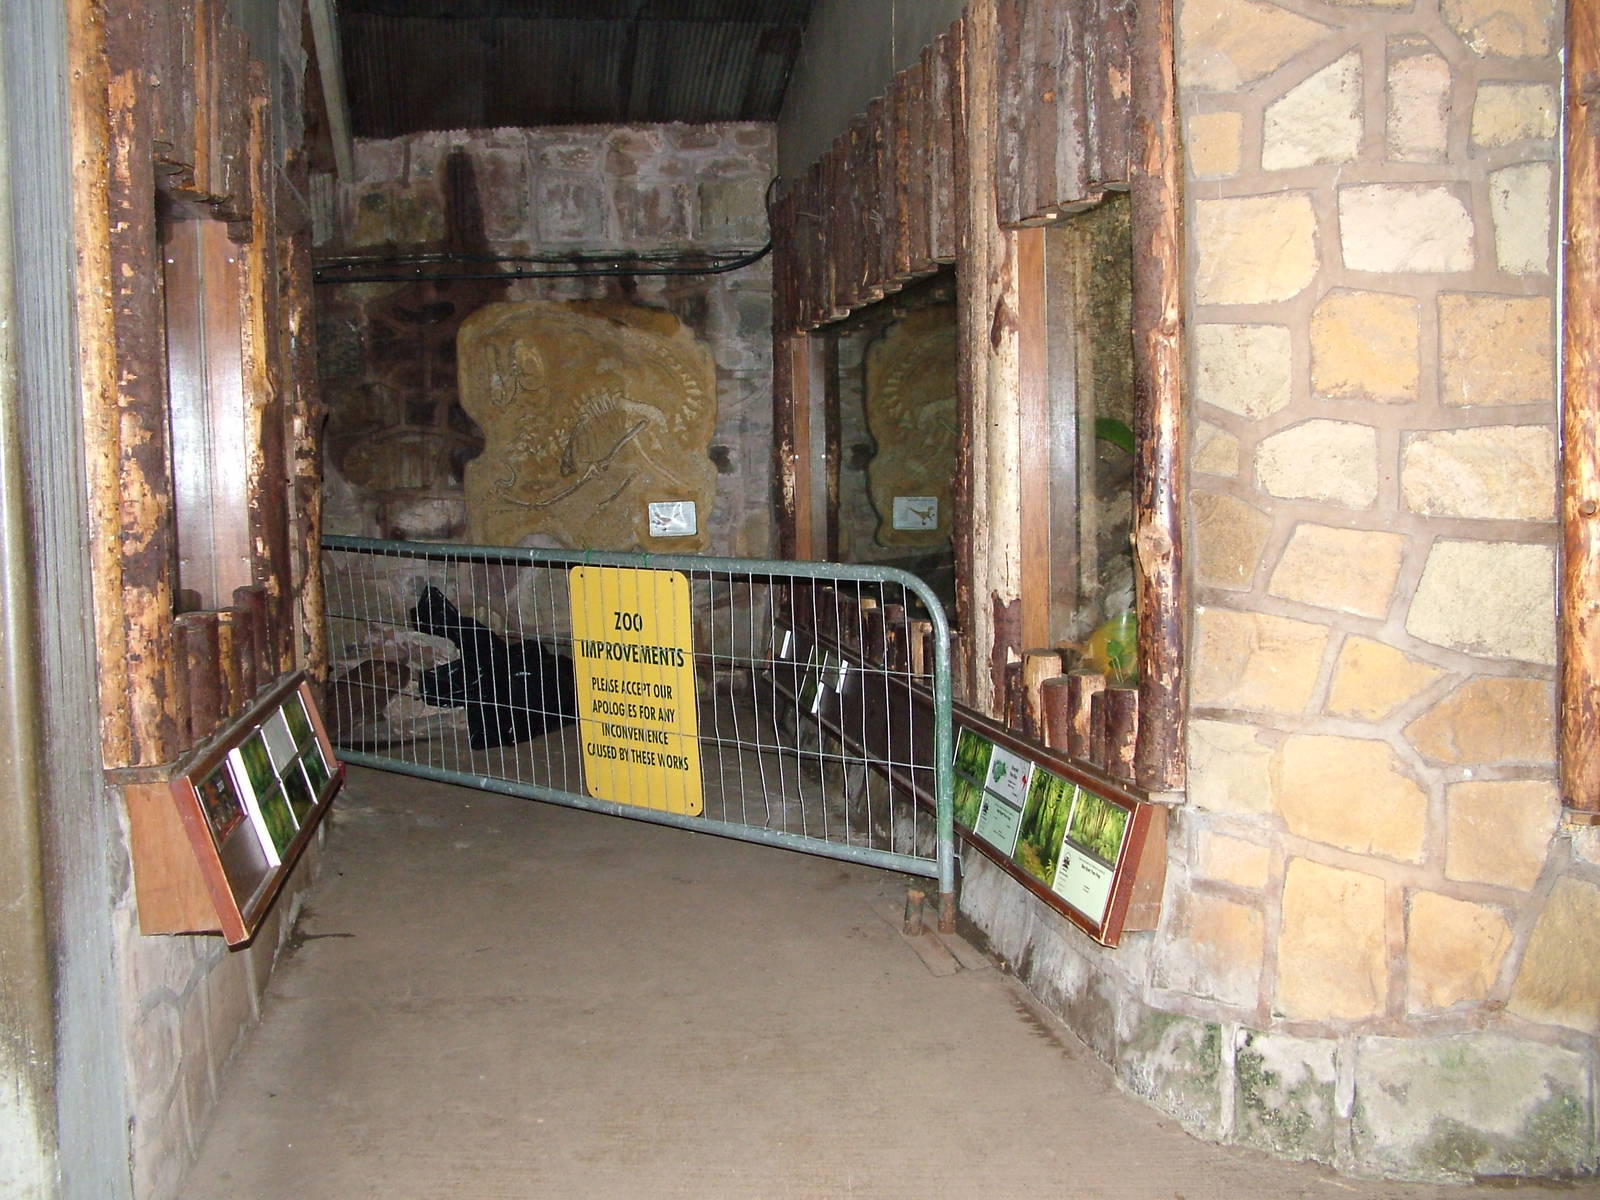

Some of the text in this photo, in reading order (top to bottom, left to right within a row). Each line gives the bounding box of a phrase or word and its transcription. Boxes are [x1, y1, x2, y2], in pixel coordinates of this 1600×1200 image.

[614, 611, 644, 632] ZOO
[581, 640, 685, 668] IMPROVEMENTS
[592, 677, 673, 699] PLEASE ACCEPT OUR
[592, 699, 675, 723] APOLOGES FOR ANY
[587, 742, 689, 771] CAUSED BY THESE WORKS
